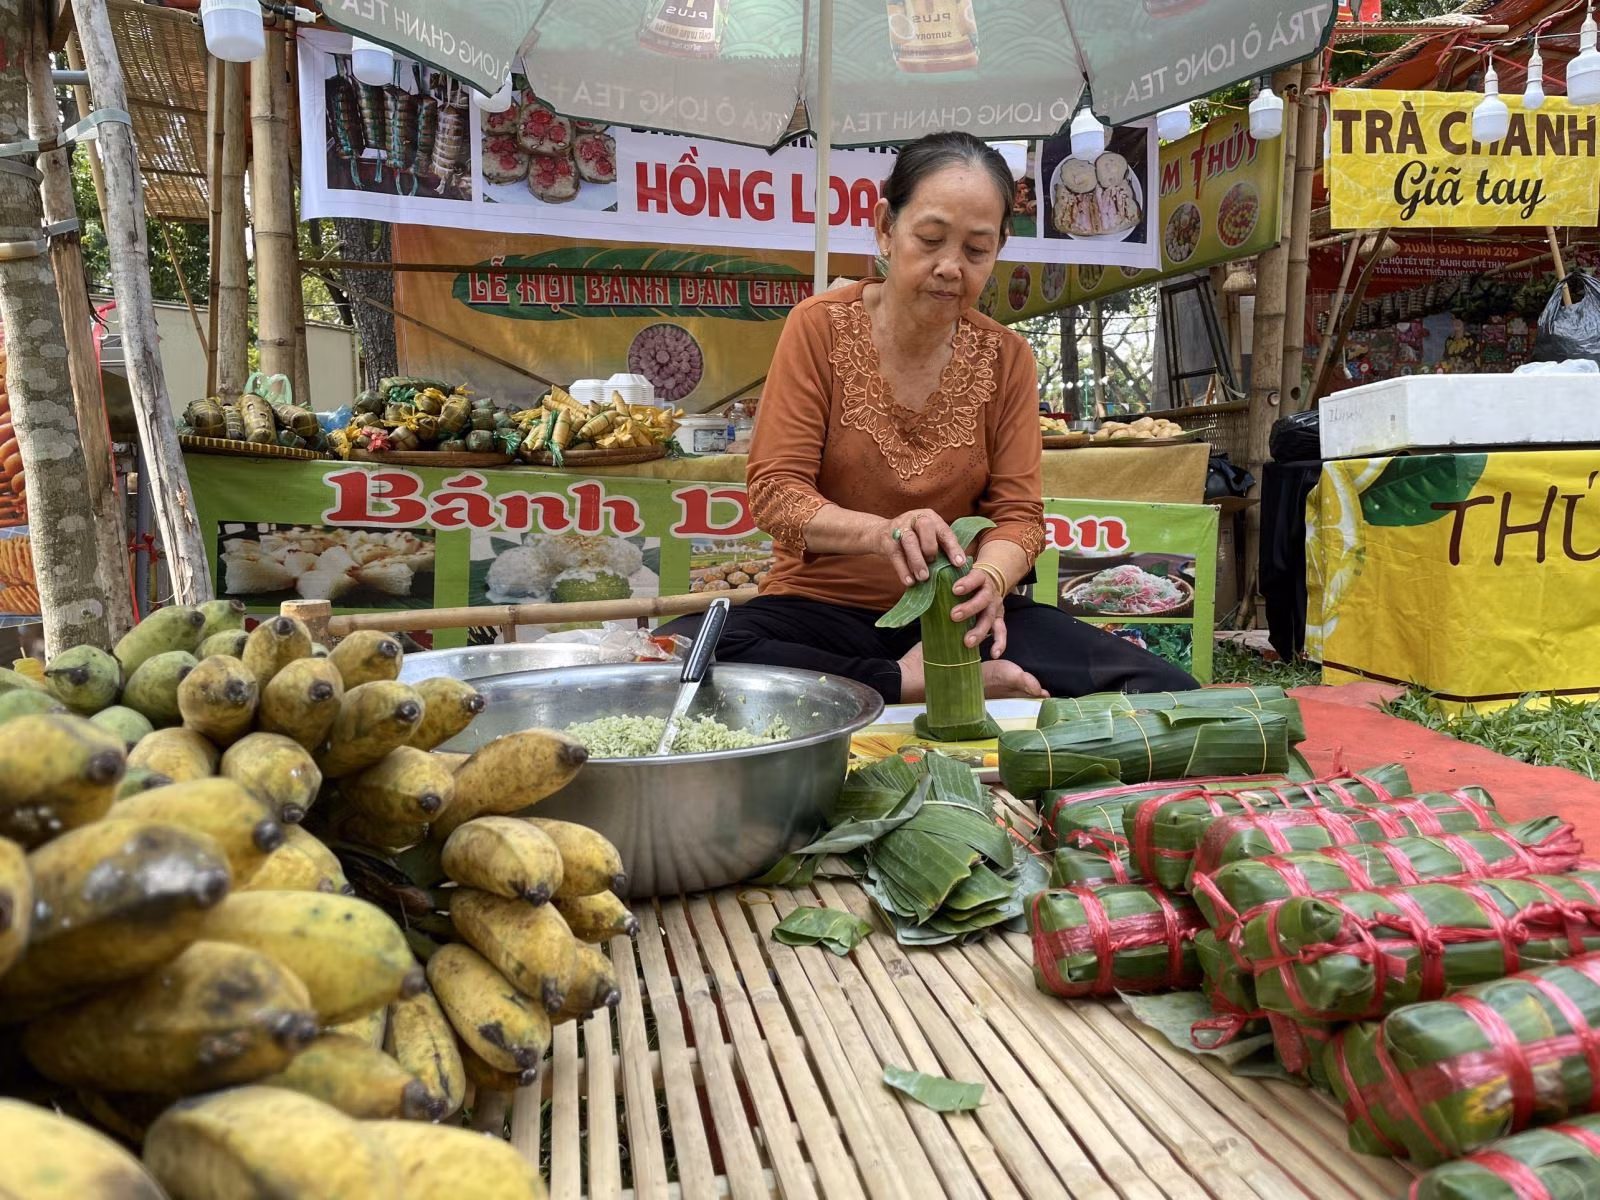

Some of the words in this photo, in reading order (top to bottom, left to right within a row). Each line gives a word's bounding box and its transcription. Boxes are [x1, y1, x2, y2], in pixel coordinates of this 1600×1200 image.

[1333, 101, 1427, 155] TRÀ
[1439, 111, 1596, 157] CANH
[635, 145, 776, 222] HỒNG
[791, 173, 888, 229] LOA
[1393, 160, 1464, 221] Giã
[1476, 168, 1547, 220] tay
[1493, 246, 1519, 257] 2024
[322, 470, 643, 536] Bánh
[1044, 515, 1130, 551] an
